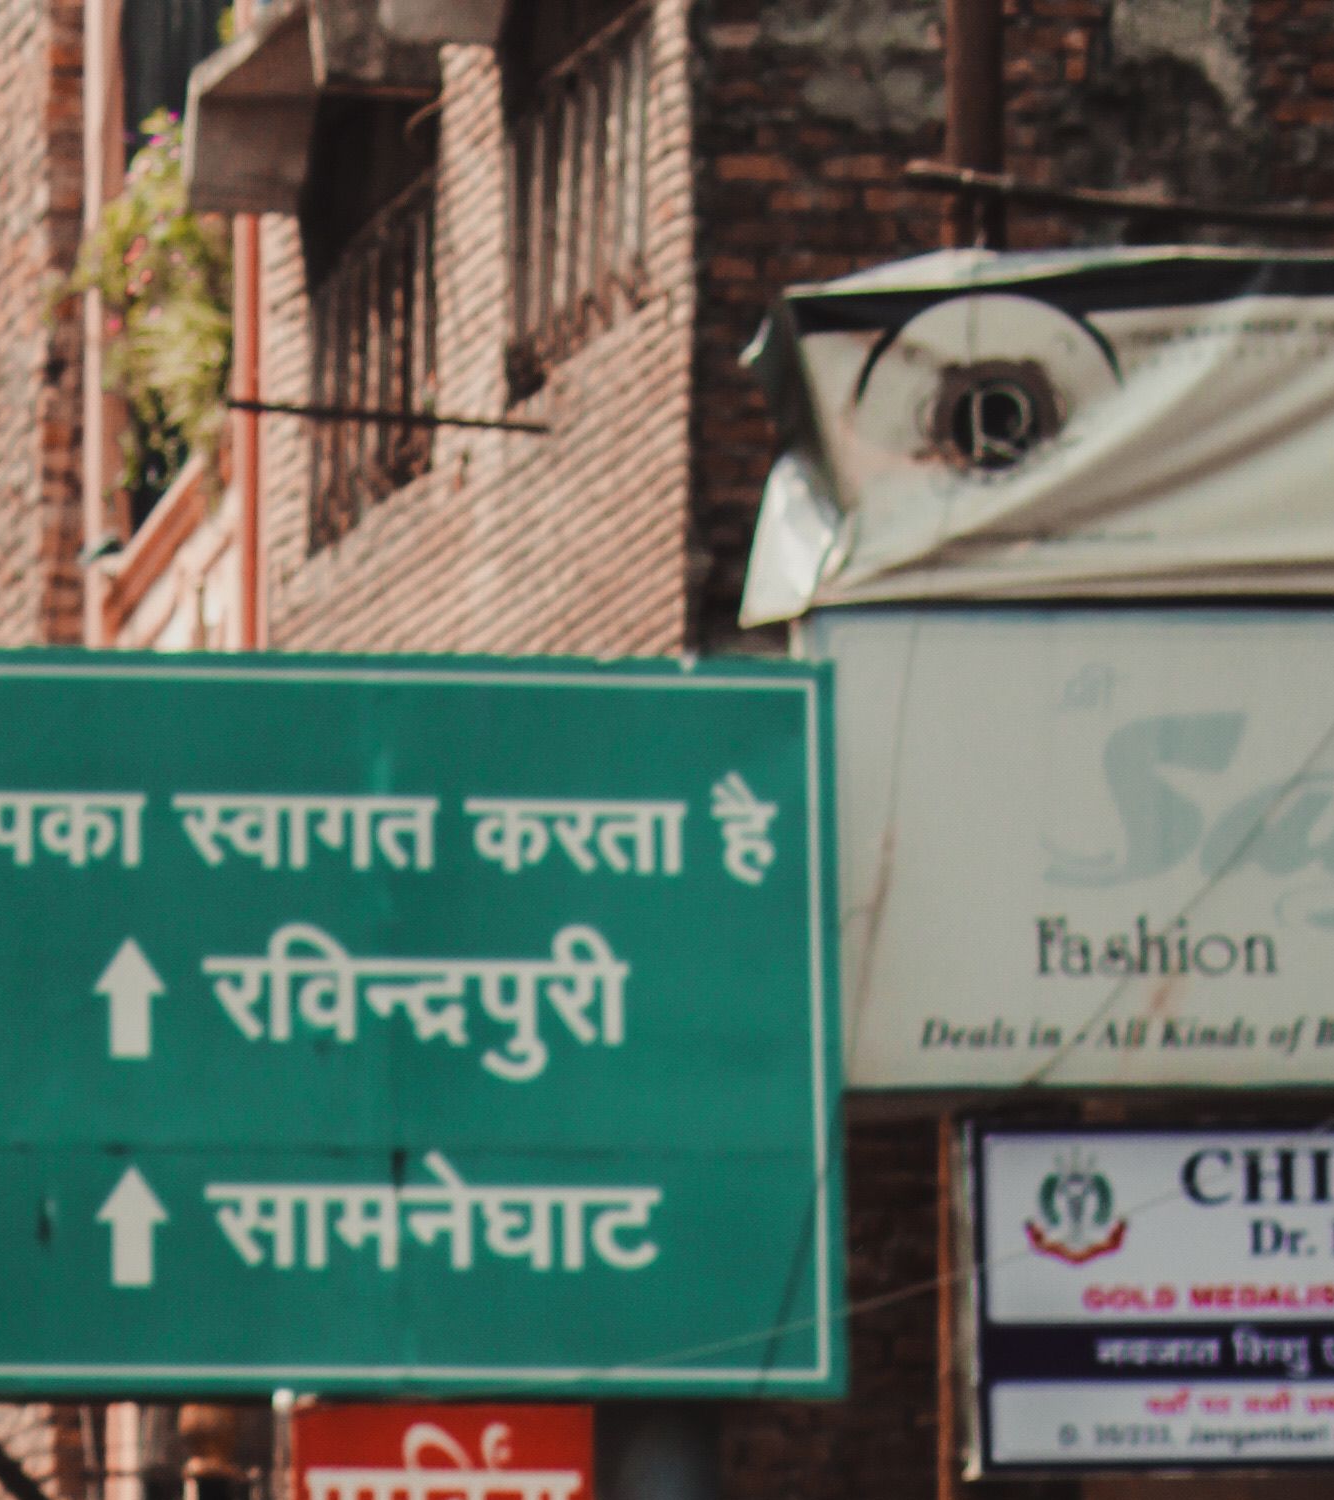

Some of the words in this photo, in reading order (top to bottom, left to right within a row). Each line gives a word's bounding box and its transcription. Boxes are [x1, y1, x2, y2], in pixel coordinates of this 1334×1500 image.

[171, 794, 439, 873] स्वागत
[463, 798, 687, 876] करता
[708, 772, 779, 885] है
[1034, 918, 1279, 981] Fashion
[200, 922, 631, 1084] रविन्द्रपुरी
[1160, 1017, 1257, 1050] Kinds
[1268, 1015, 1311, 1055] of
[204, 1152, 663, 1272] सामनेघाट
[1248, 1216, 1319, 1259] Dr.
[1082, 1284, 1178, 1312] GOLD
